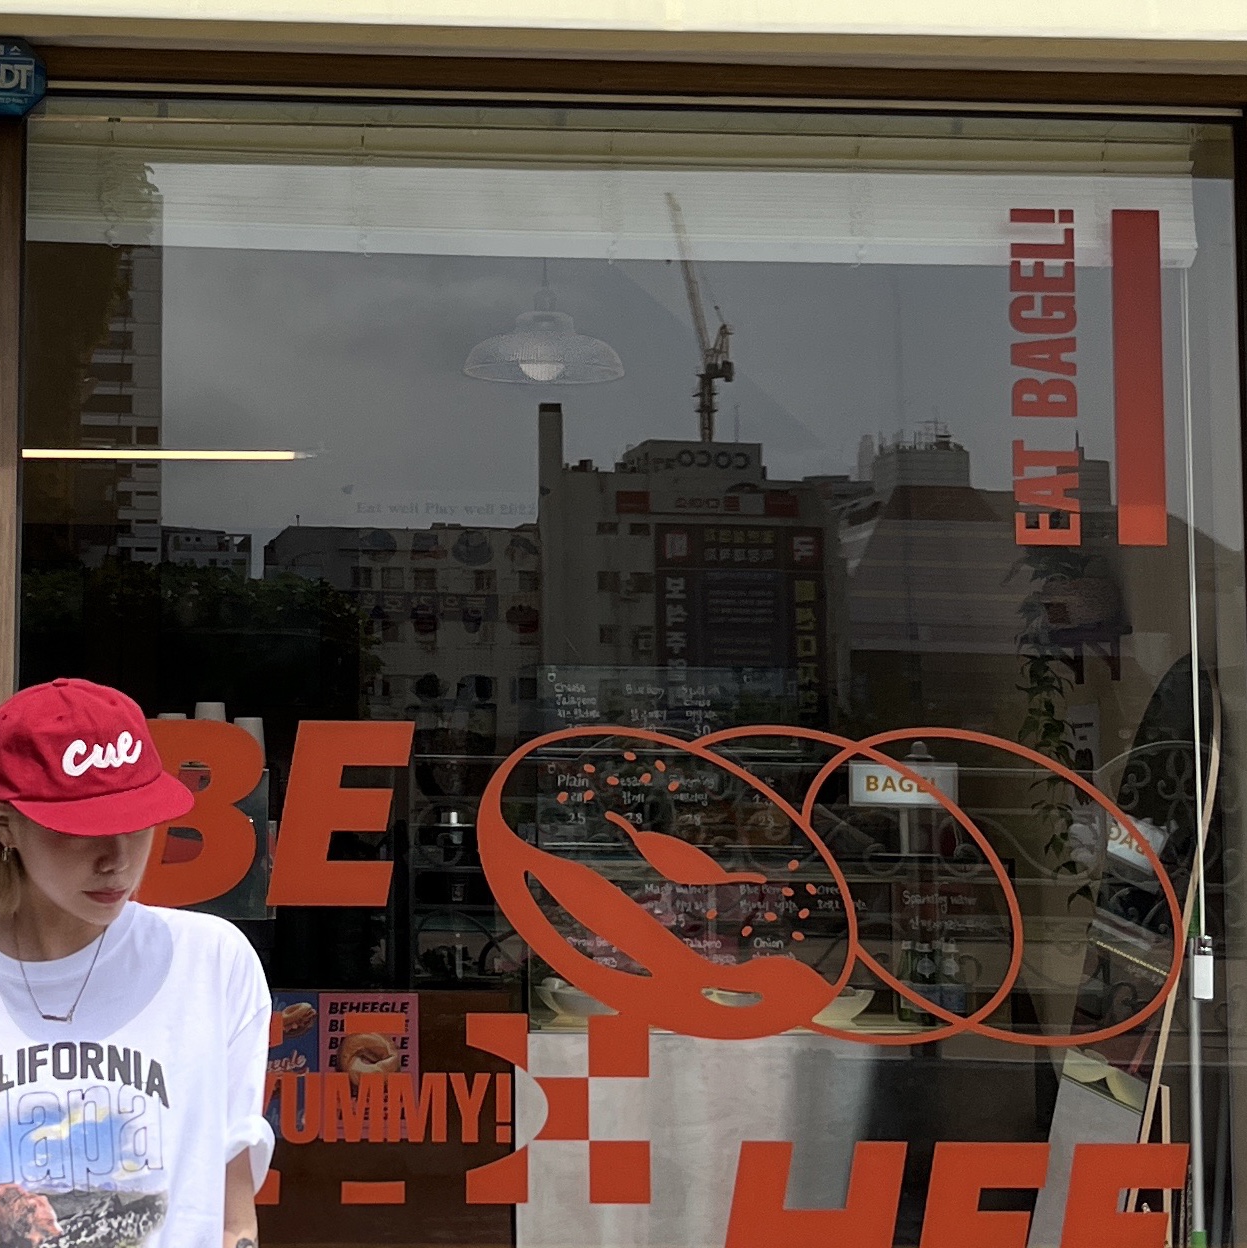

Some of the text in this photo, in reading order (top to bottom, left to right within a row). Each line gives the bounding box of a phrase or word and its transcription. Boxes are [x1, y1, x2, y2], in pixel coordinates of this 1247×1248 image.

[1009, 208, 1082, 546] EAT BAGEL!
[557, 772, 590, 788] Plain
[134, 719, 415, 907] BE
[753, 935, 784, 950] Onion
[328, 1001, 411, 1015] BEHEEGLE
